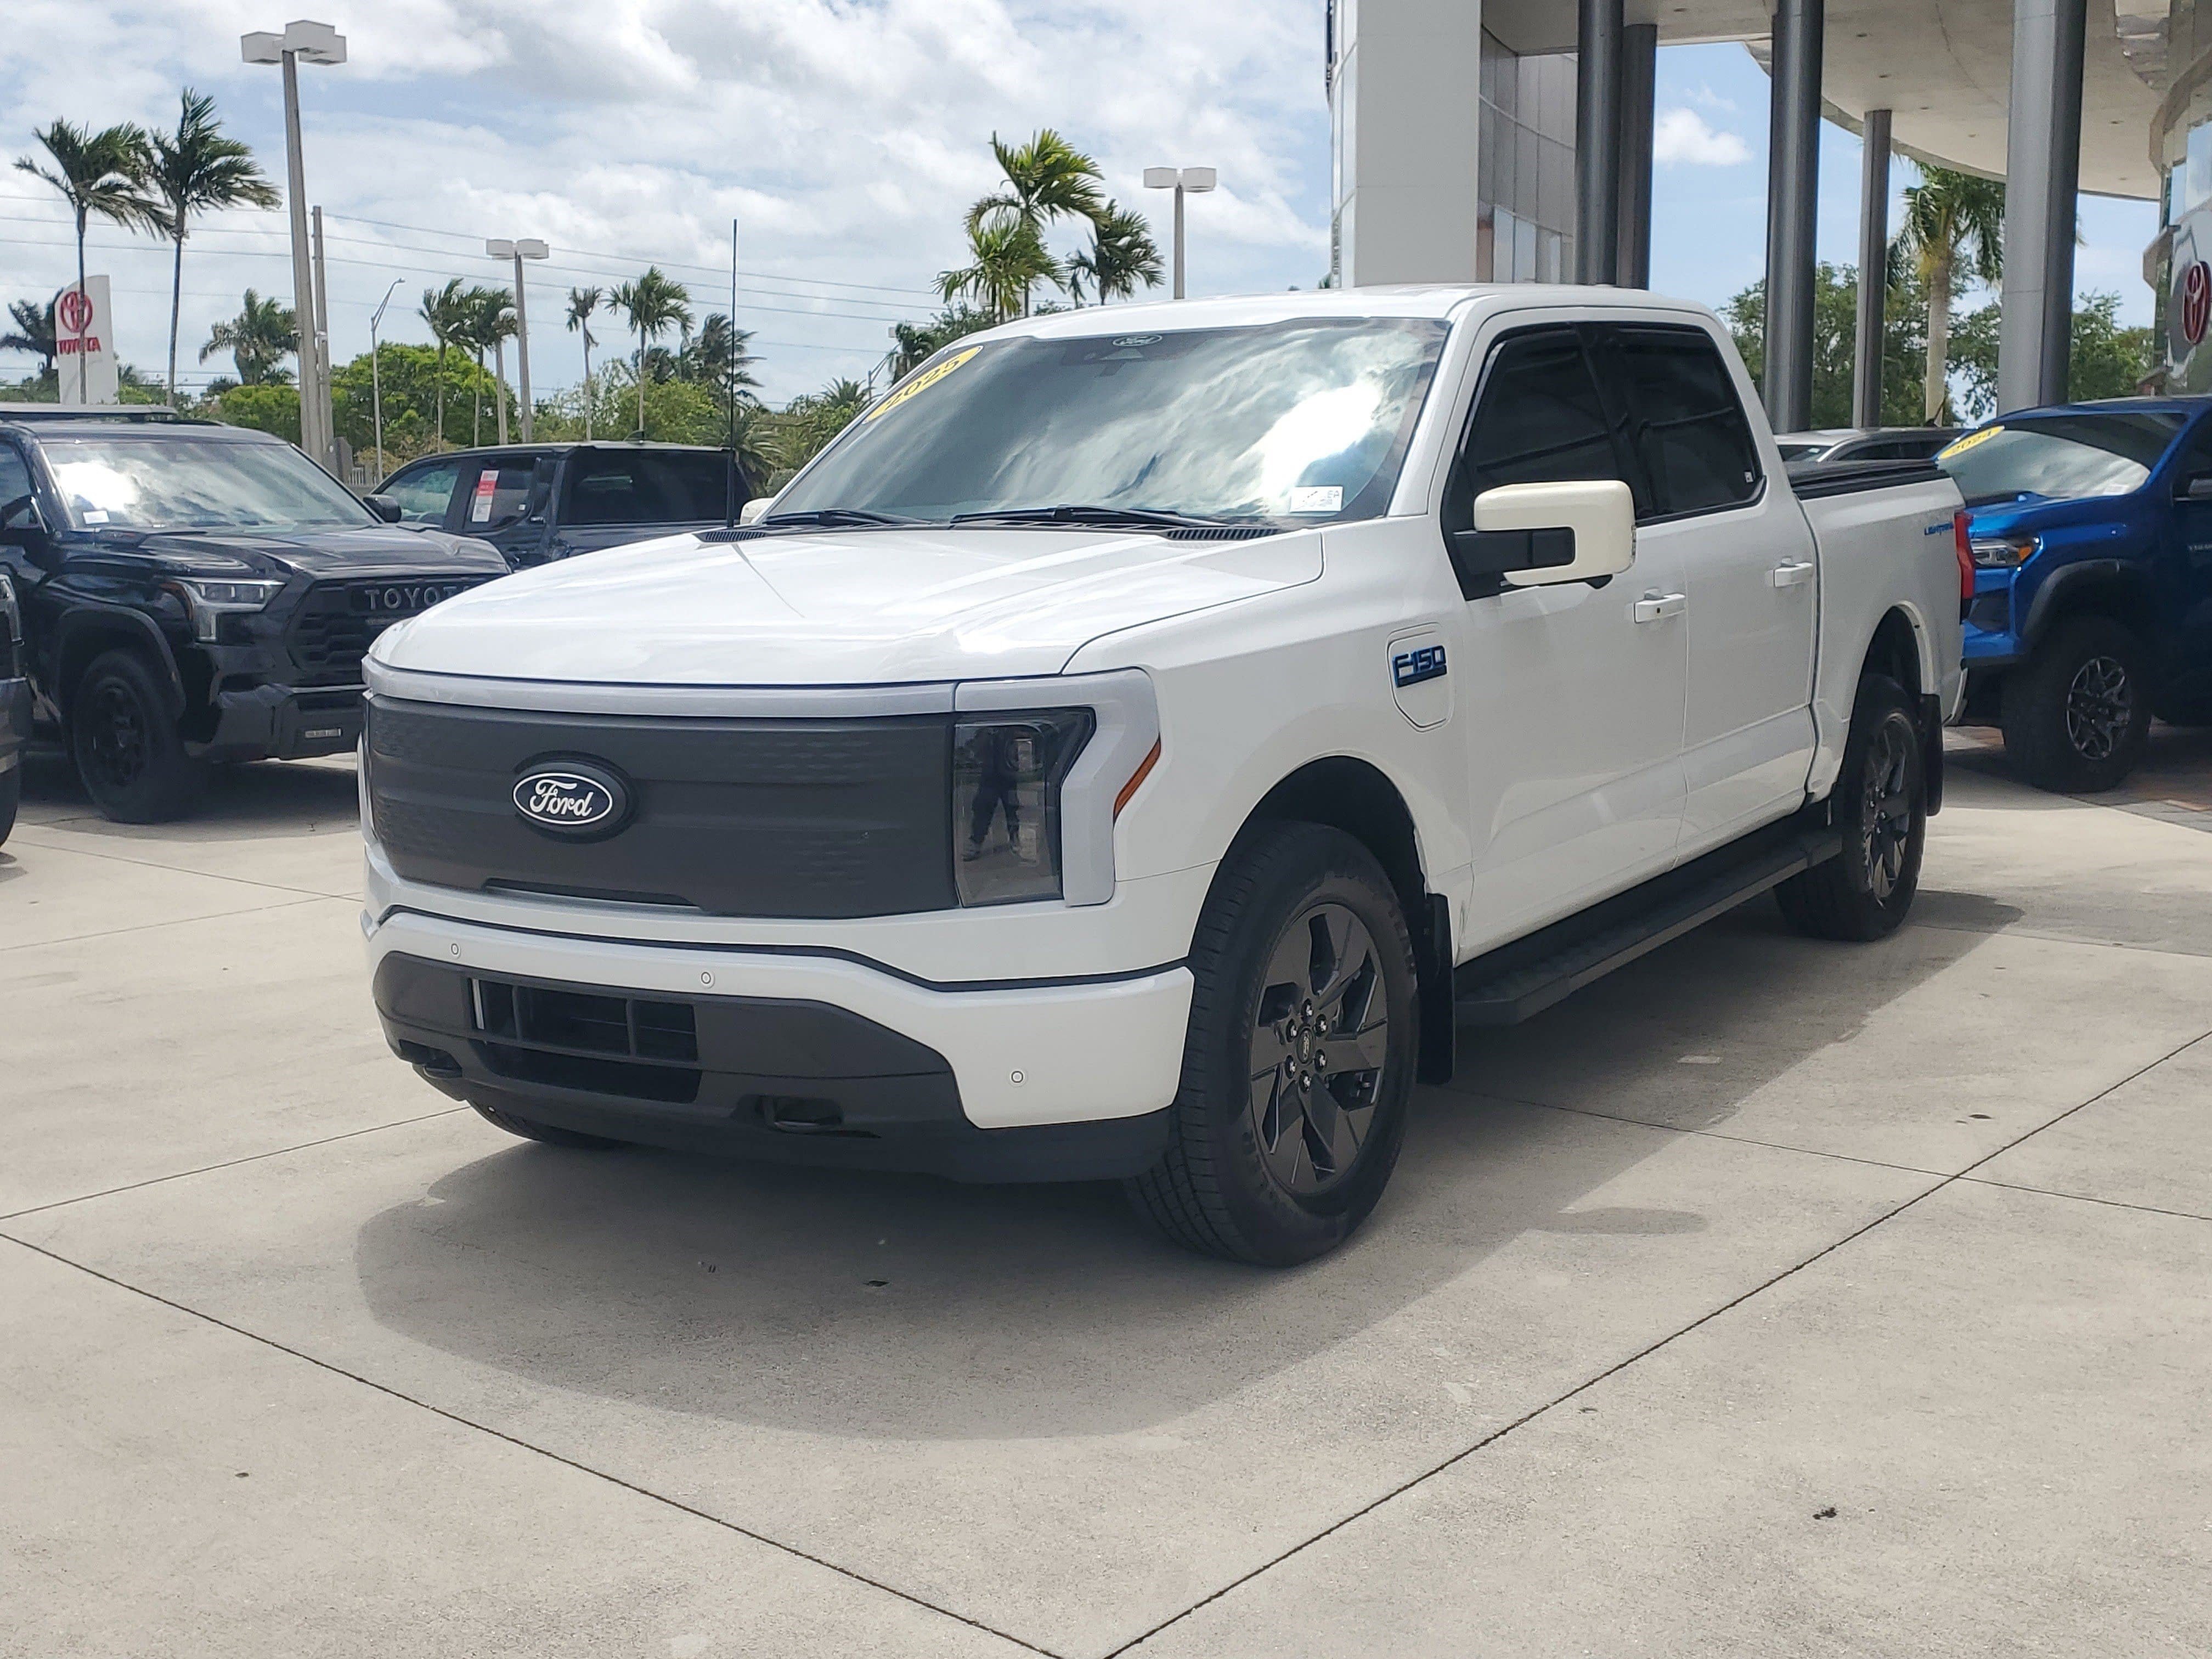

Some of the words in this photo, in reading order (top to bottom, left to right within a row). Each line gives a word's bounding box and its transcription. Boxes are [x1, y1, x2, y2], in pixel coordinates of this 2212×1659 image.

[57, 336, 101, 354] TOYTA
[884, 356, 961, 411] 2025
[364, 585, 471, 610] TOYOT
[529, 779, 594, 817] Ford
